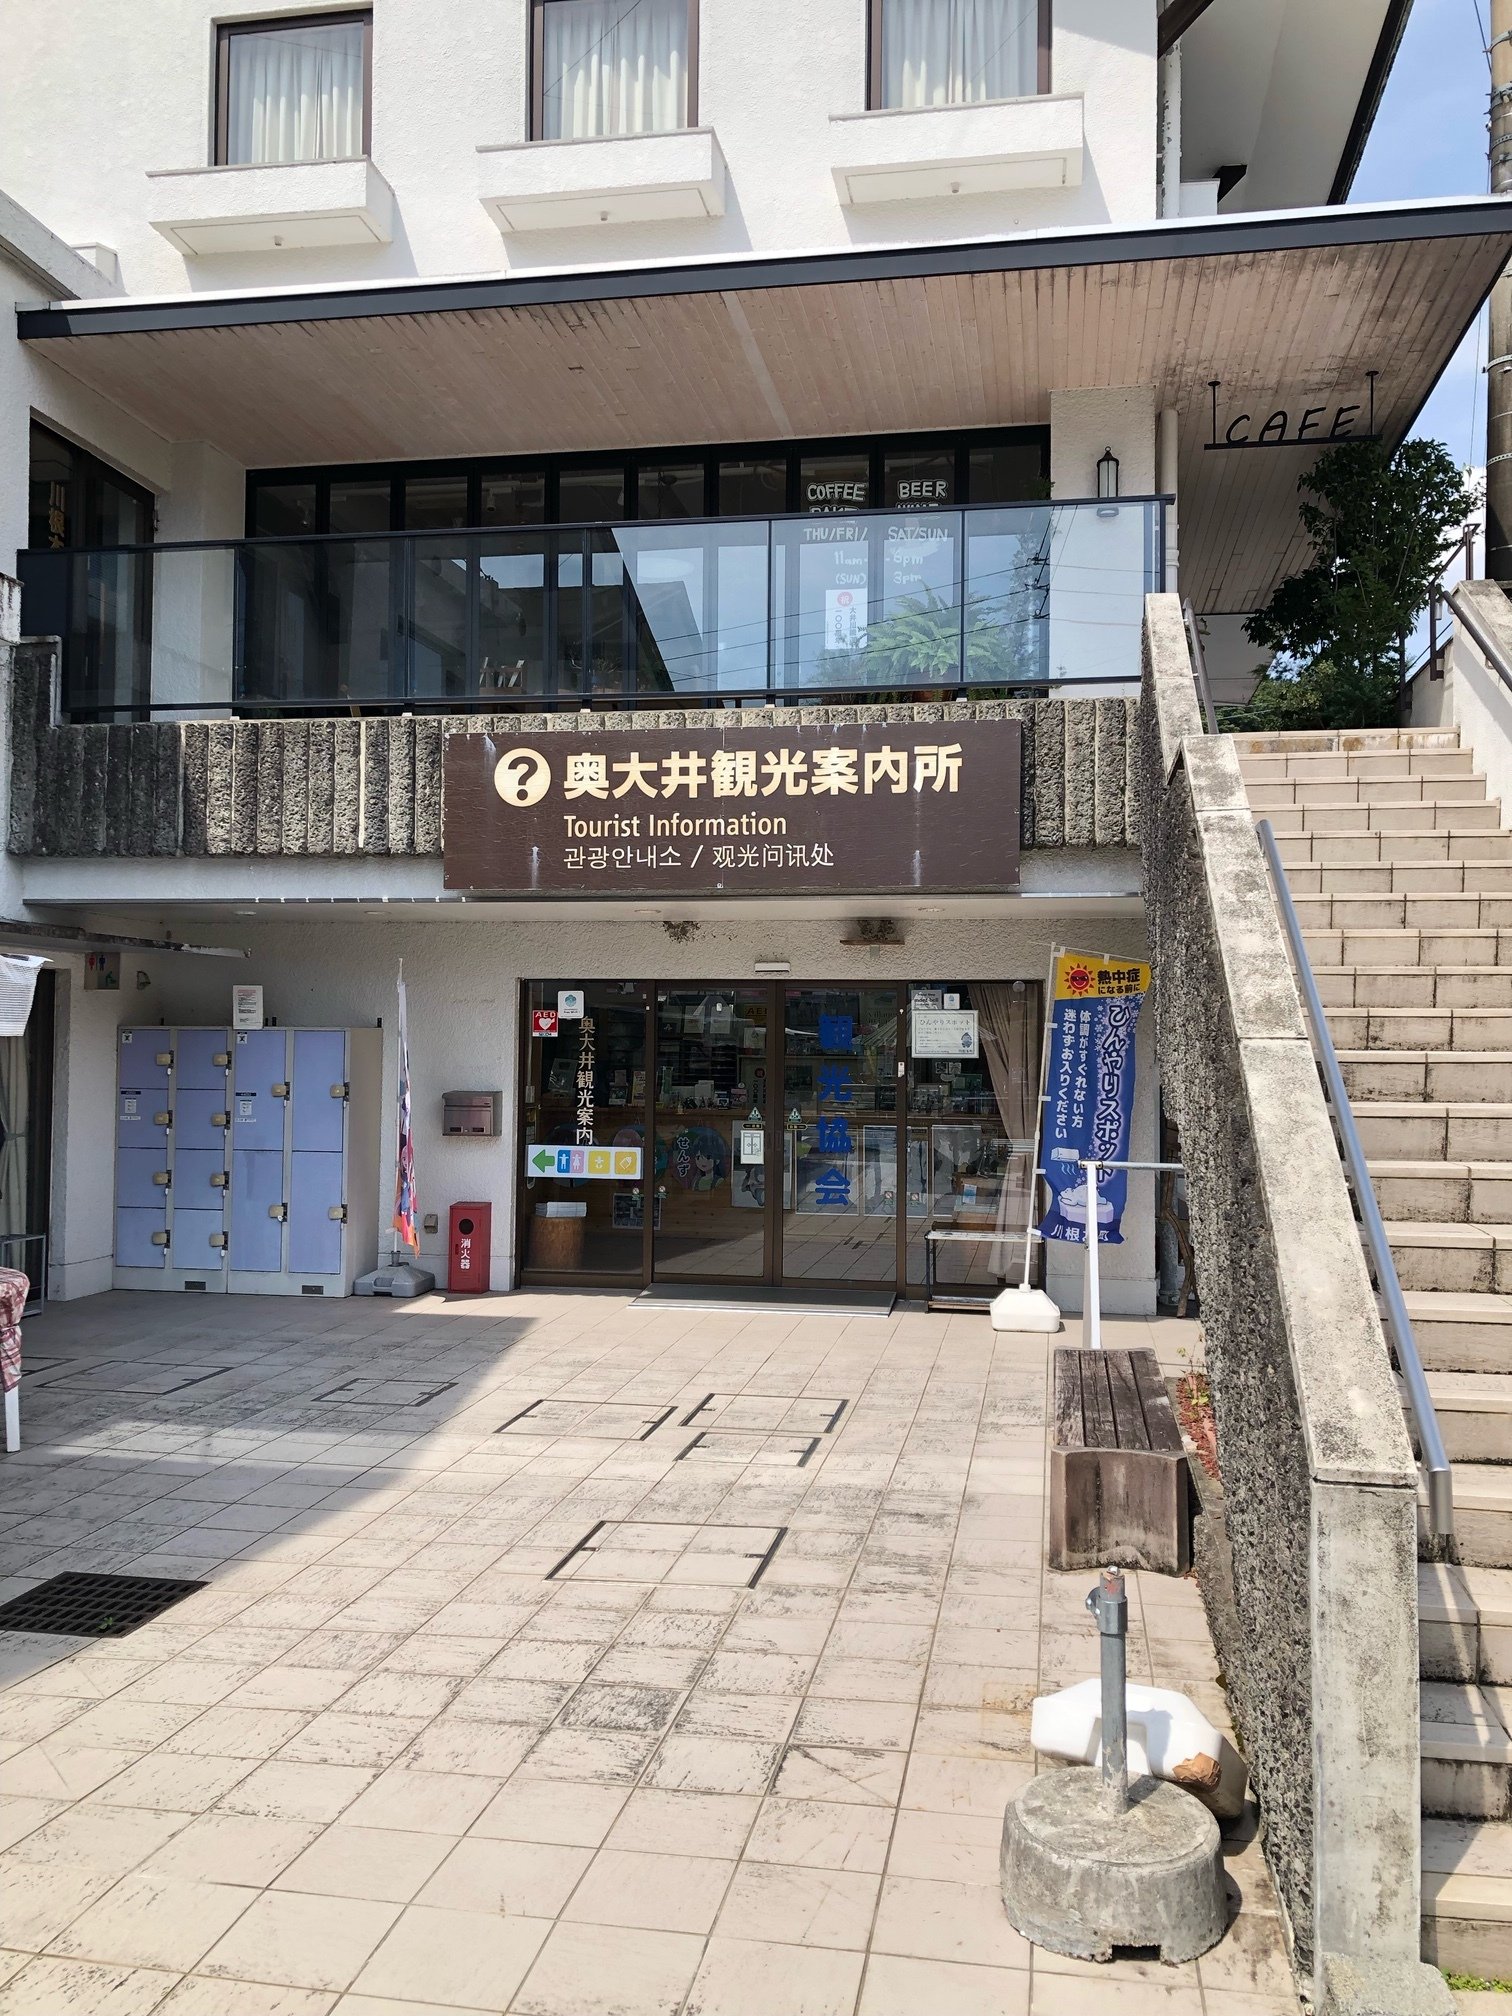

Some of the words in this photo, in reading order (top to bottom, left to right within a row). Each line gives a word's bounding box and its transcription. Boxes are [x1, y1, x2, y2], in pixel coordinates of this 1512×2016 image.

[1225, 405, 1361, 443] CAFE
[807, 481, 867, 502] COFFEE
[897, 479, 948, 499] BEER
[887, 526, 948, 542] SAT/SUN
[835, 572, 867, 586] (SUN)
[563, 742, 963, 800] 奥大井観光案内所
[564, 814, 641, 838] Tourist
[648, 810, 788, 836] Information
[563, 845, 682, 870] 관광안내소
[690, 846, 703, 868] /
[711, 843, 835, 868] 观光问讯处
[1097, 967, 1141, 985] 熱中症
[1097, 983, 1141, 995] になる前に
[534, 1011, 557, 1019] AED
[1055, 1008, 1077, 1139] 迷わずお入りください
[1071, 1009, 1092, 1129] 体調がすぐれない方
[1095, 1004, 1131, 1183] ひんやりスポット
[460, 1238, 471, 1270] 消火器
